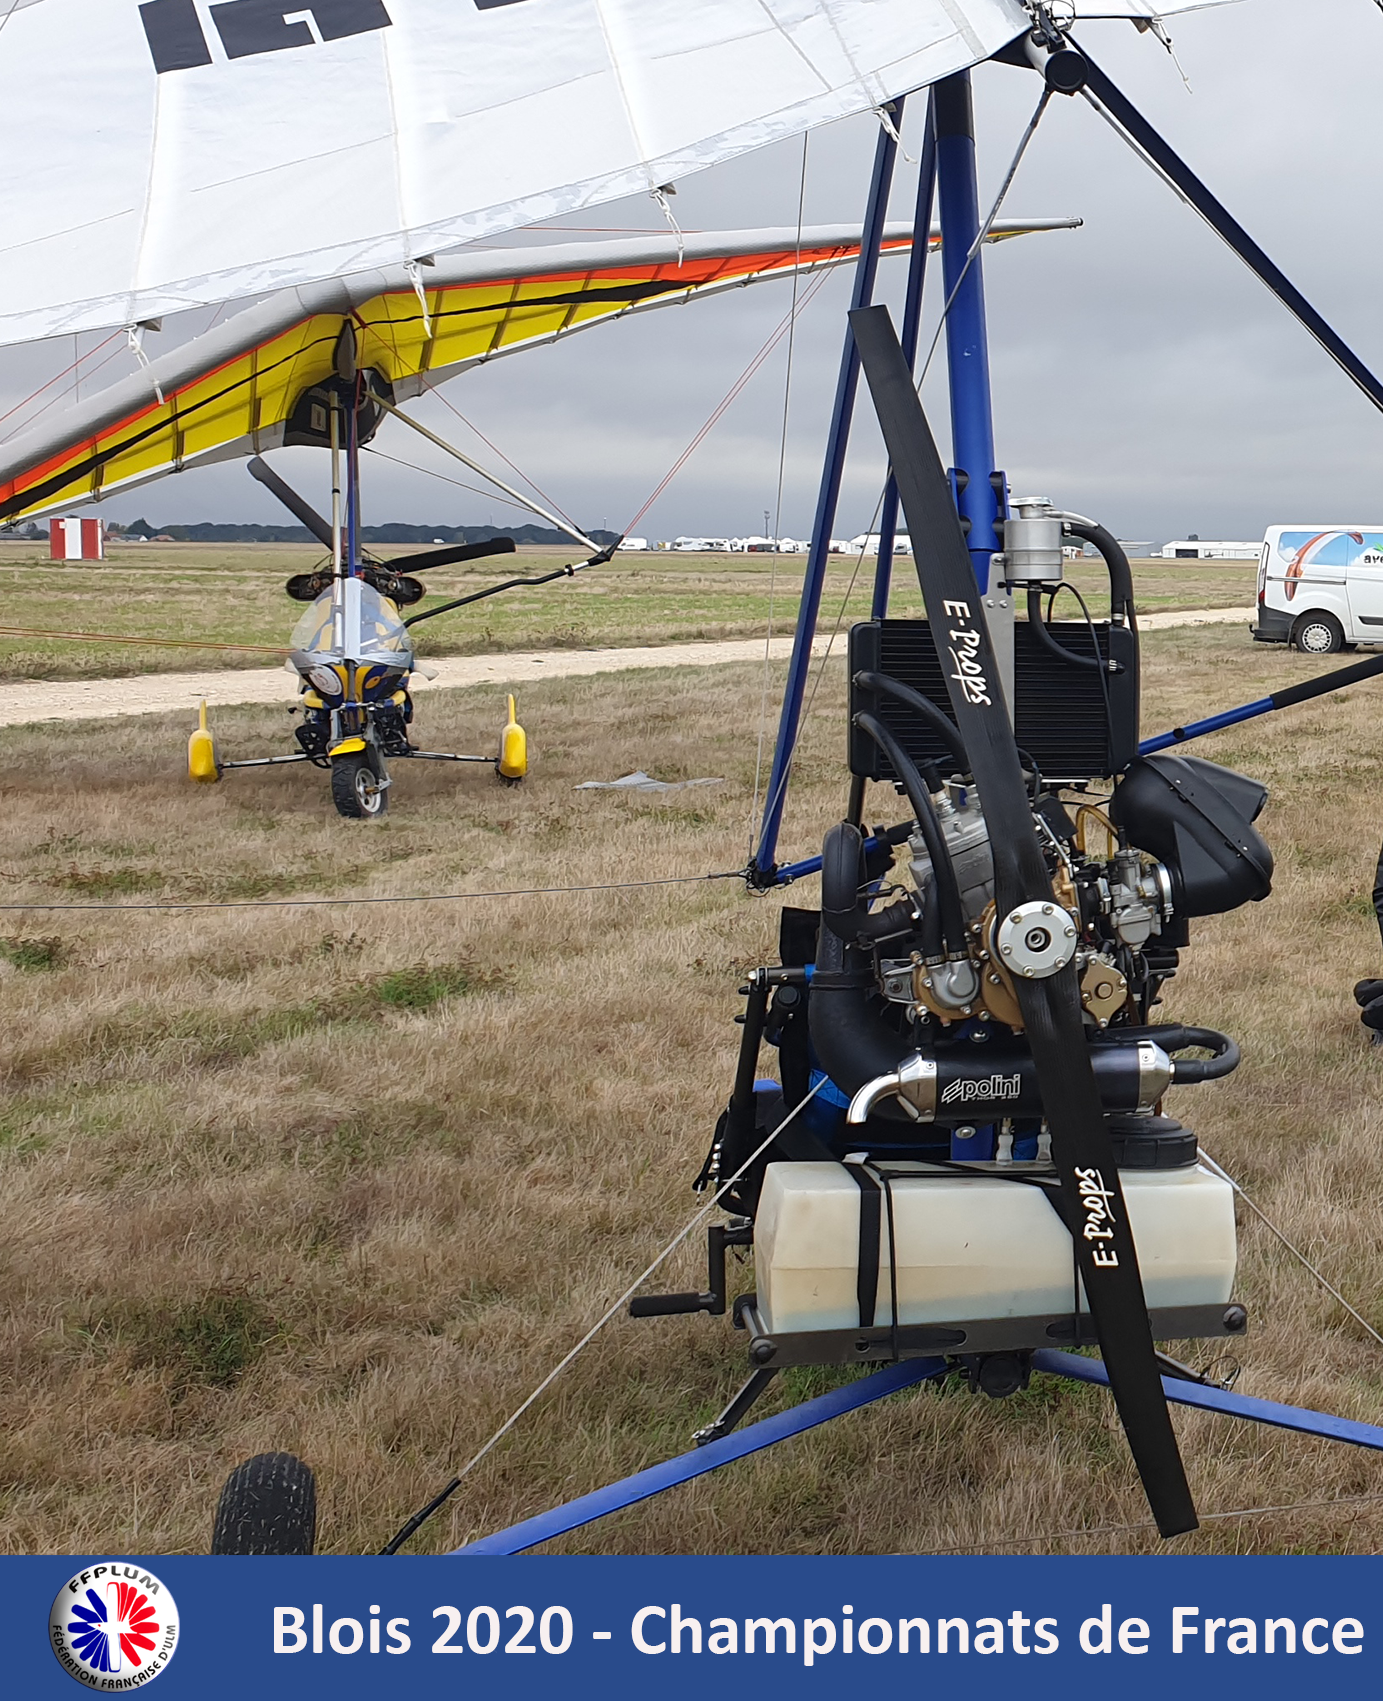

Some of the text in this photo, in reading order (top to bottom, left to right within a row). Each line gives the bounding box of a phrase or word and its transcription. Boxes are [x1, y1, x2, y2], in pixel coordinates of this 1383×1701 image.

[943, 600, 992, 706] E-Props
[961, 1074, 1021, 1101] polini
[1074, 1166, 1120, 1267] E-Props
